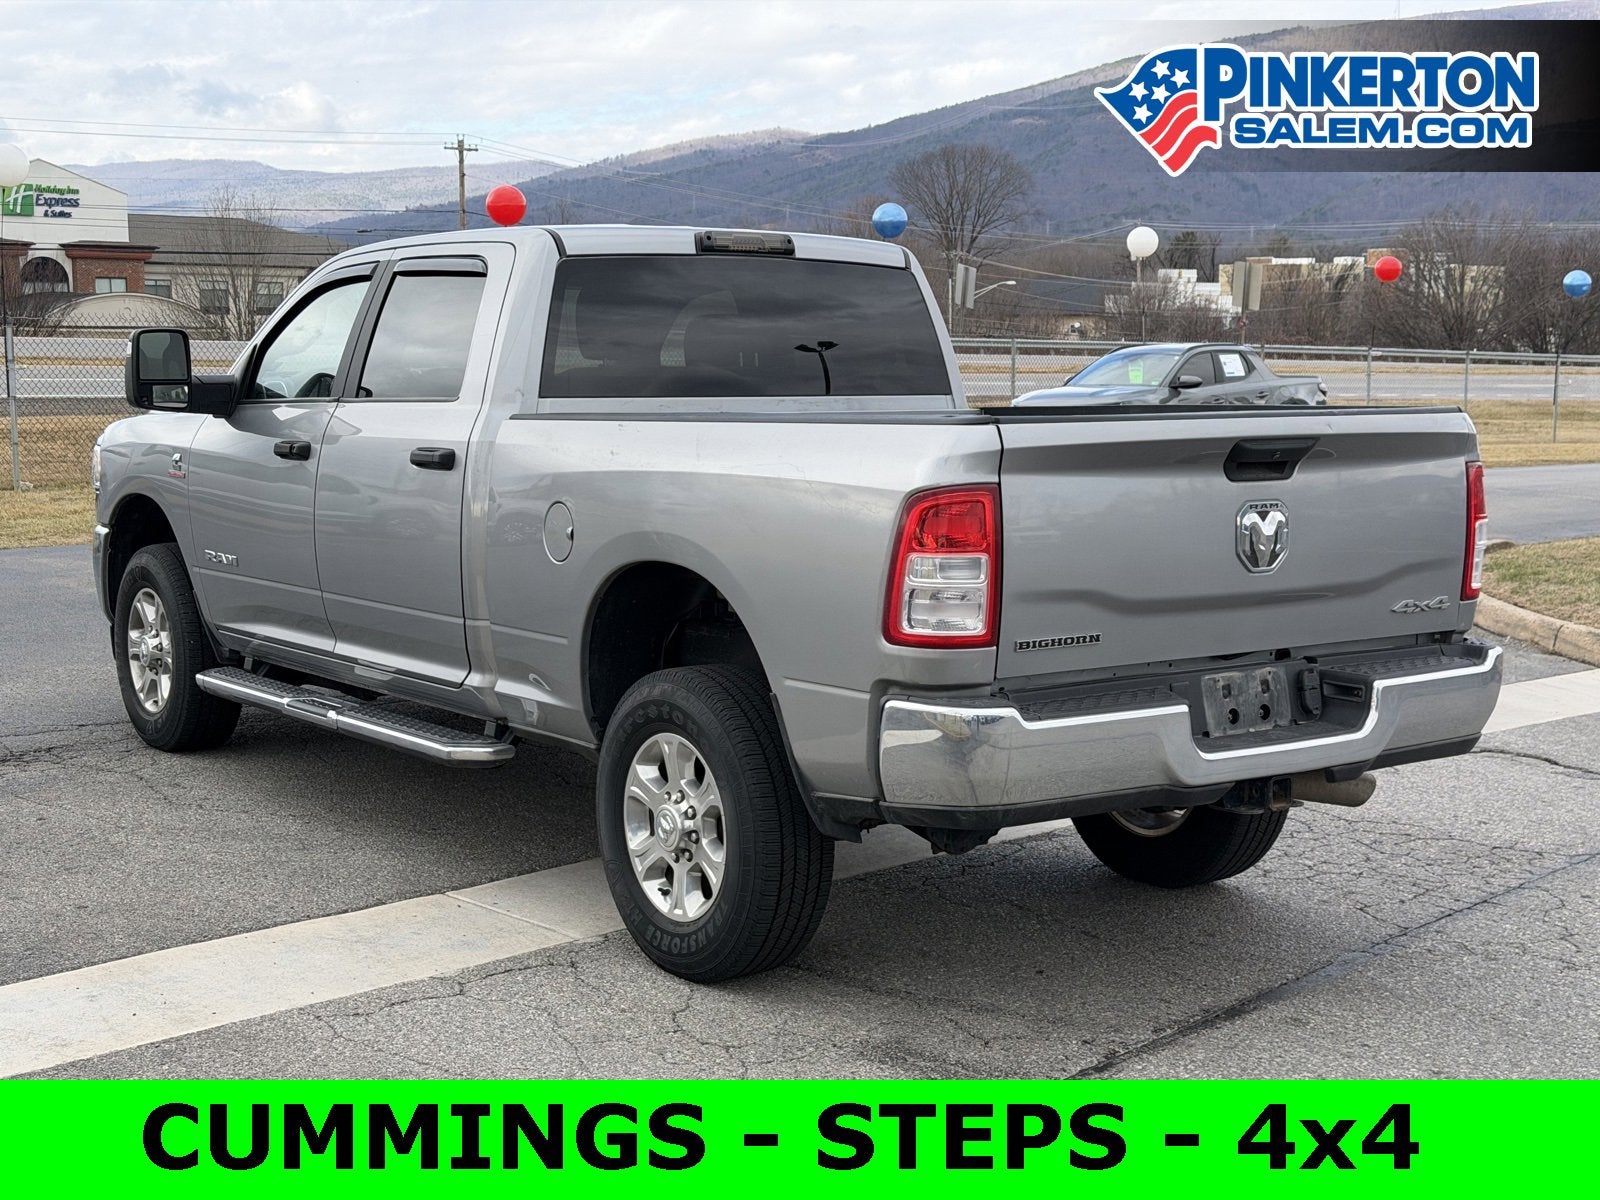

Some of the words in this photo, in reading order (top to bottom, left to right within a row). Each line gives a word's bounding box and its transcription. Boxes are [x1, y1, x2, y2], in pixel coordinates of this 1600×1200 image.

[34, 184, 65, 195] Holiday
[35, 194, 80, 209] Express
[50, 209, 72, 218] Suites
[1016, 633, 1102, 652] BIGHORN
